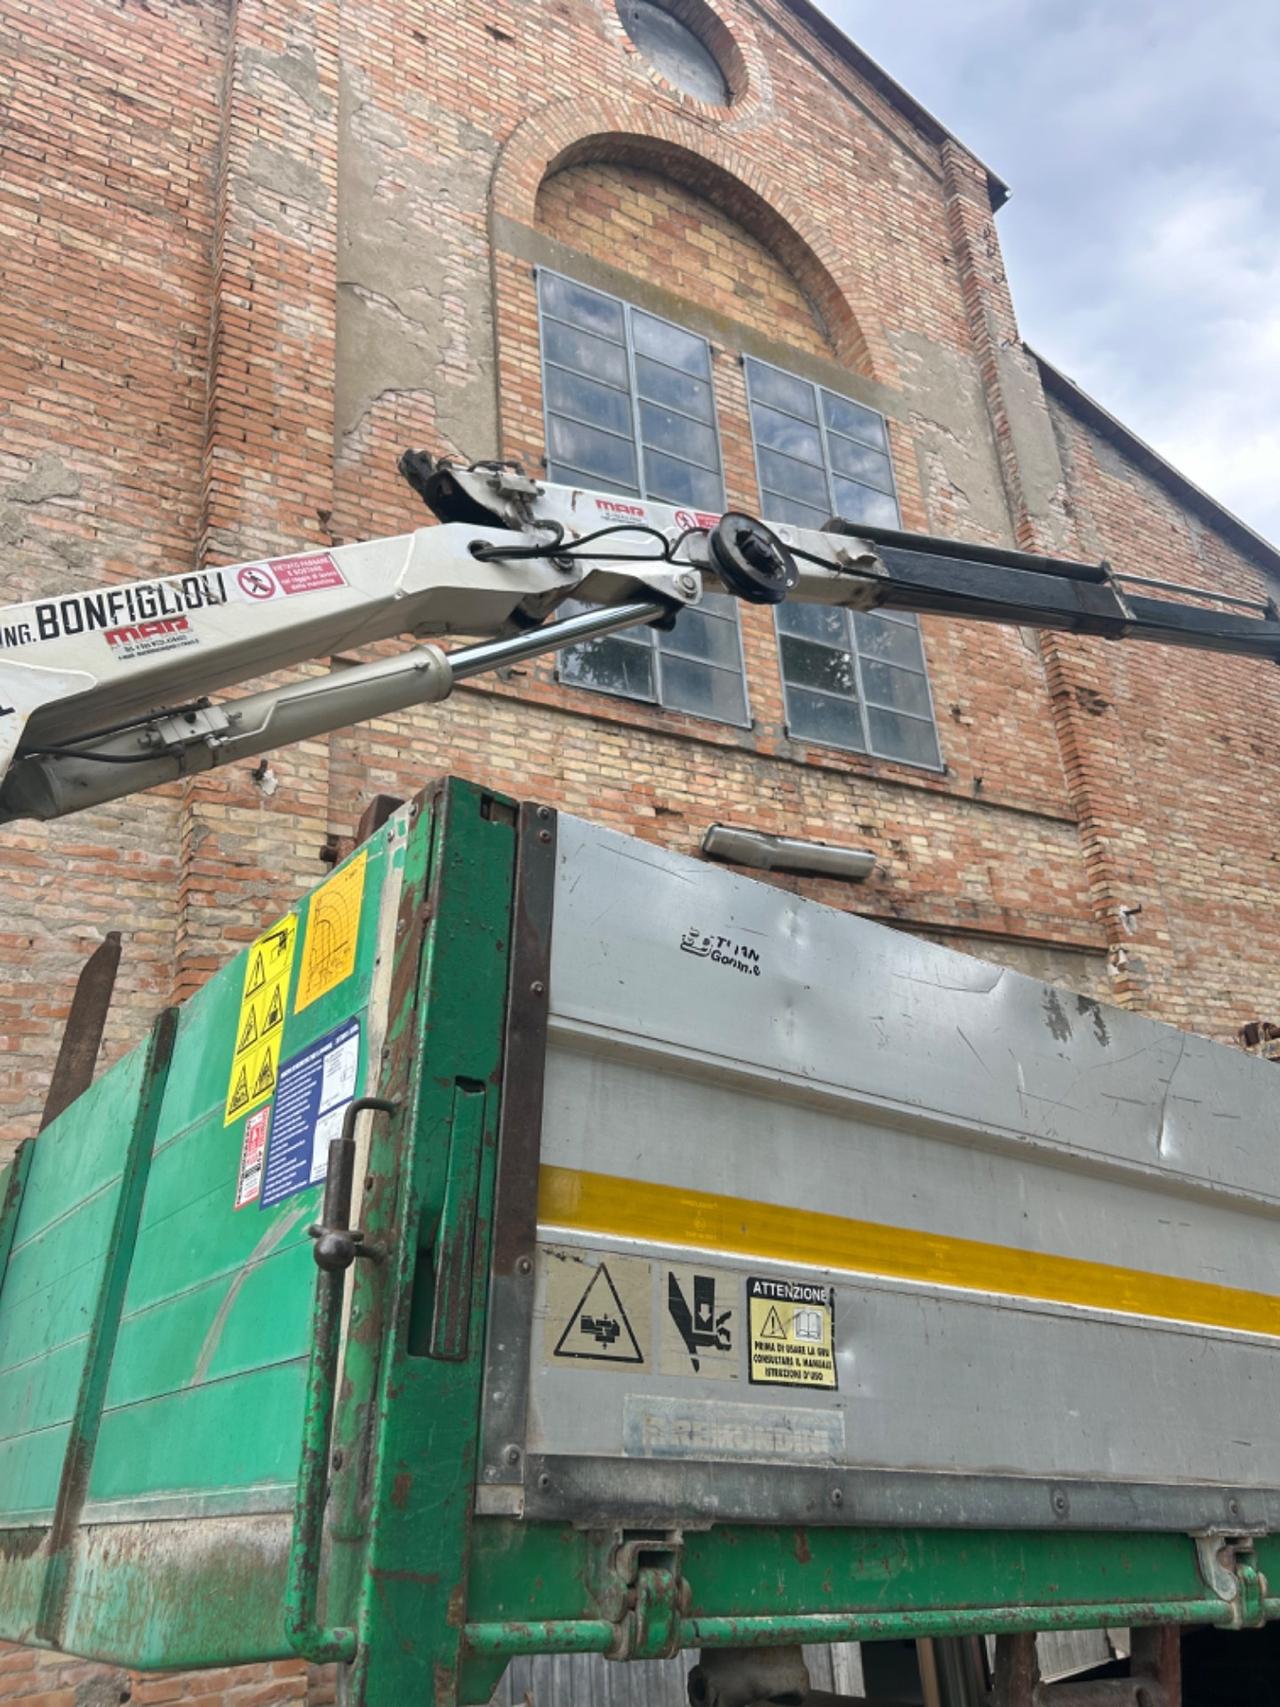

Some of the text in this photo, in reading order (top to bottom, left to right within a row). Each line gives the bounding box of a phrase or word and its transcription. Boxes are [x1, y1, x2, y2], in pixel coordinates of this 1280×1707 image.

[36, 572, 228, 640] BONFIGLIOLI
[752, 1281, 827, 1301] ATTENZIONE
[754, 1340, 776, 1352] PRIMA
[777, 1342, 785, 1353] DI
[785, 1343, 806, 1355] USARE
[807, 1345, 815, 1356] LA
[753, 1353, 794, 1366] CONSULTARE
